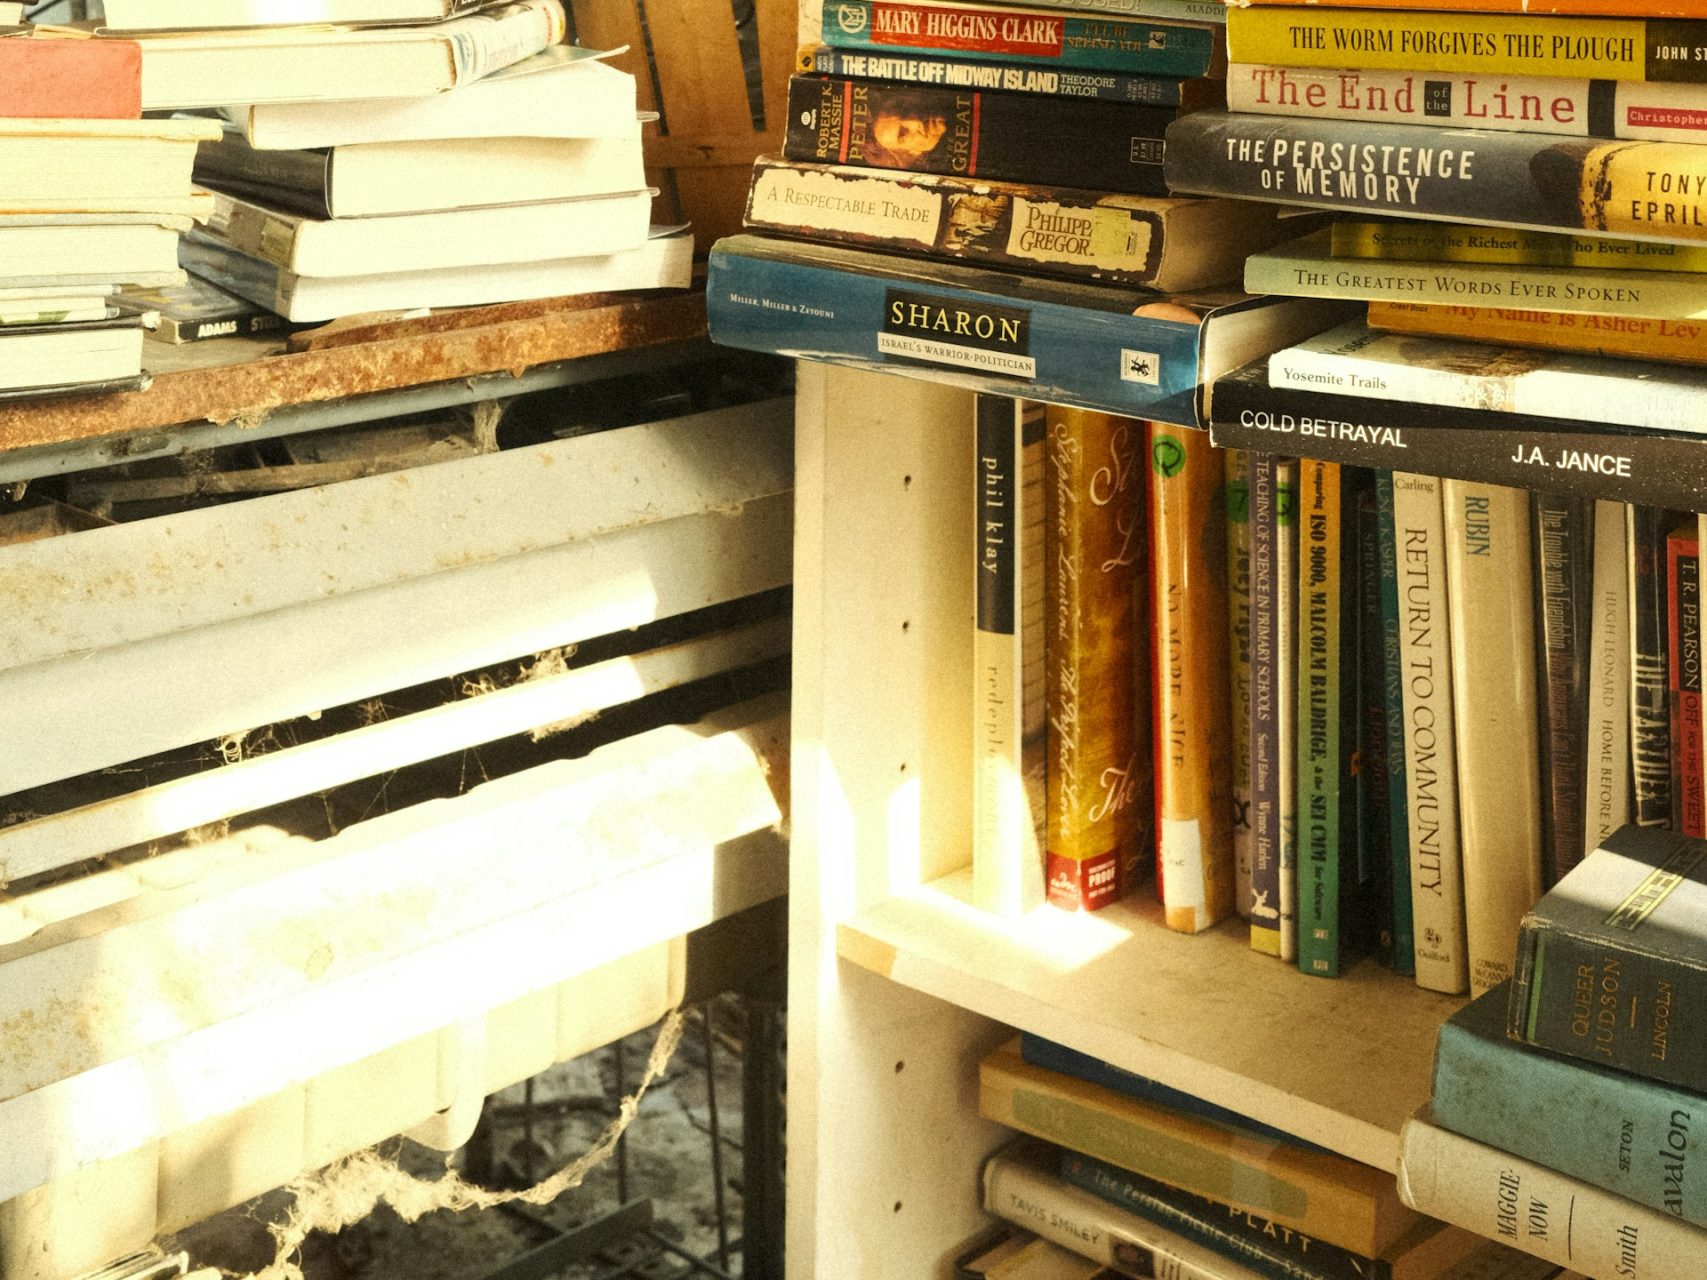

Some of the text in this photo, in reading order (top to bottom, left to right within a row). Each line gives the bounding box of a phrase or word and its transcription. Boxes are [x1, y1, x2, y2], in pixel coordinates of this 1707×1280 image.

[876, 9, 1058, 45] MARY HIGGINS CLARK
[1289, 26, 1688, 62] THE WORM FORGIVES THE PLOUGH JOHN
[841, 54, 866, 77] THE
[868, 56, 918, 82] BATTLE
[918, 61, 945, 83] OFF
[946, 64, 1002, 89] MIDWAY
[1003, 69, 1058, 94] ISLAND
[1060, 73, 1116, 88] THEODORE
[1060, 84, 1098, 97] TAYLOR
[1252, 68, 1574, 123] The End of the Line
[816, 99, 833, 158] ROBERT
[829, 94, 843, 150] MASSIE
[849, 86, 971, 172] PETER GREAT
[1226, 138, 1475, 180] THE PERSISTENCE
[1261, 167, 1420, 205] OF MEMORY
[1646, 171, 1707, 196] TONY
[767, 186, 930, 223] A RESPECTABLE TRADE
[1631, 200, 1704, 227] EPRIL
[1468, 236, 1629, 256] Richest Ever
[198, 320, 237, 338] ADAMS
[890, 300, 1021, 344] SHARON
[1583, 315, 1652, 335] Asher
[881, 337, 1033, 372] ISRAEL'S WARRIOR-POLITICIAN
[1284, 367, 1387, 390] Yosemite Trails
[1240, 410, 1631, 477] COLD BETRAYAL J.A. JANCE
[1051, 422, 1083, 537] Stephanie
[1395, 477, 1434, 493] Carling
[982, 456, 1003, 574] phil klay
[1465, 495, 1491, 558] RUBIN
[1544, 531, 1570, 593] Trouble with
[1256, 461, 1271, 721] TEACHING OF SCIENCE PRIMARY SCHOOLS
[1309, 513, 1328, 672] ISO MALCOLM
[1683, 603, 1700, 689] PEARSON
[1405, 527, 1442, 899] RETURN TO COMMUNITY
[1600, 720, 1614, 819] HOME BEFORE
[1572, 963, 1594, 1037] QUEER
[1596, 957, 1620, 1056] JUDSON
[1651, 979, 1672, 1061] LINCOLN
[1618, 1119, 1635, 1173] SETON
[1659, 1109, 1691, 1221] avalon
[1010, 1194, 1099, 1245] TAVIS SMILEY
[1498, 1168, 1521, 1240] MAGGIE-
[1529, 1195, 1549, 1242] NOW
[1615, 1224, 1638, 1280] Smith
